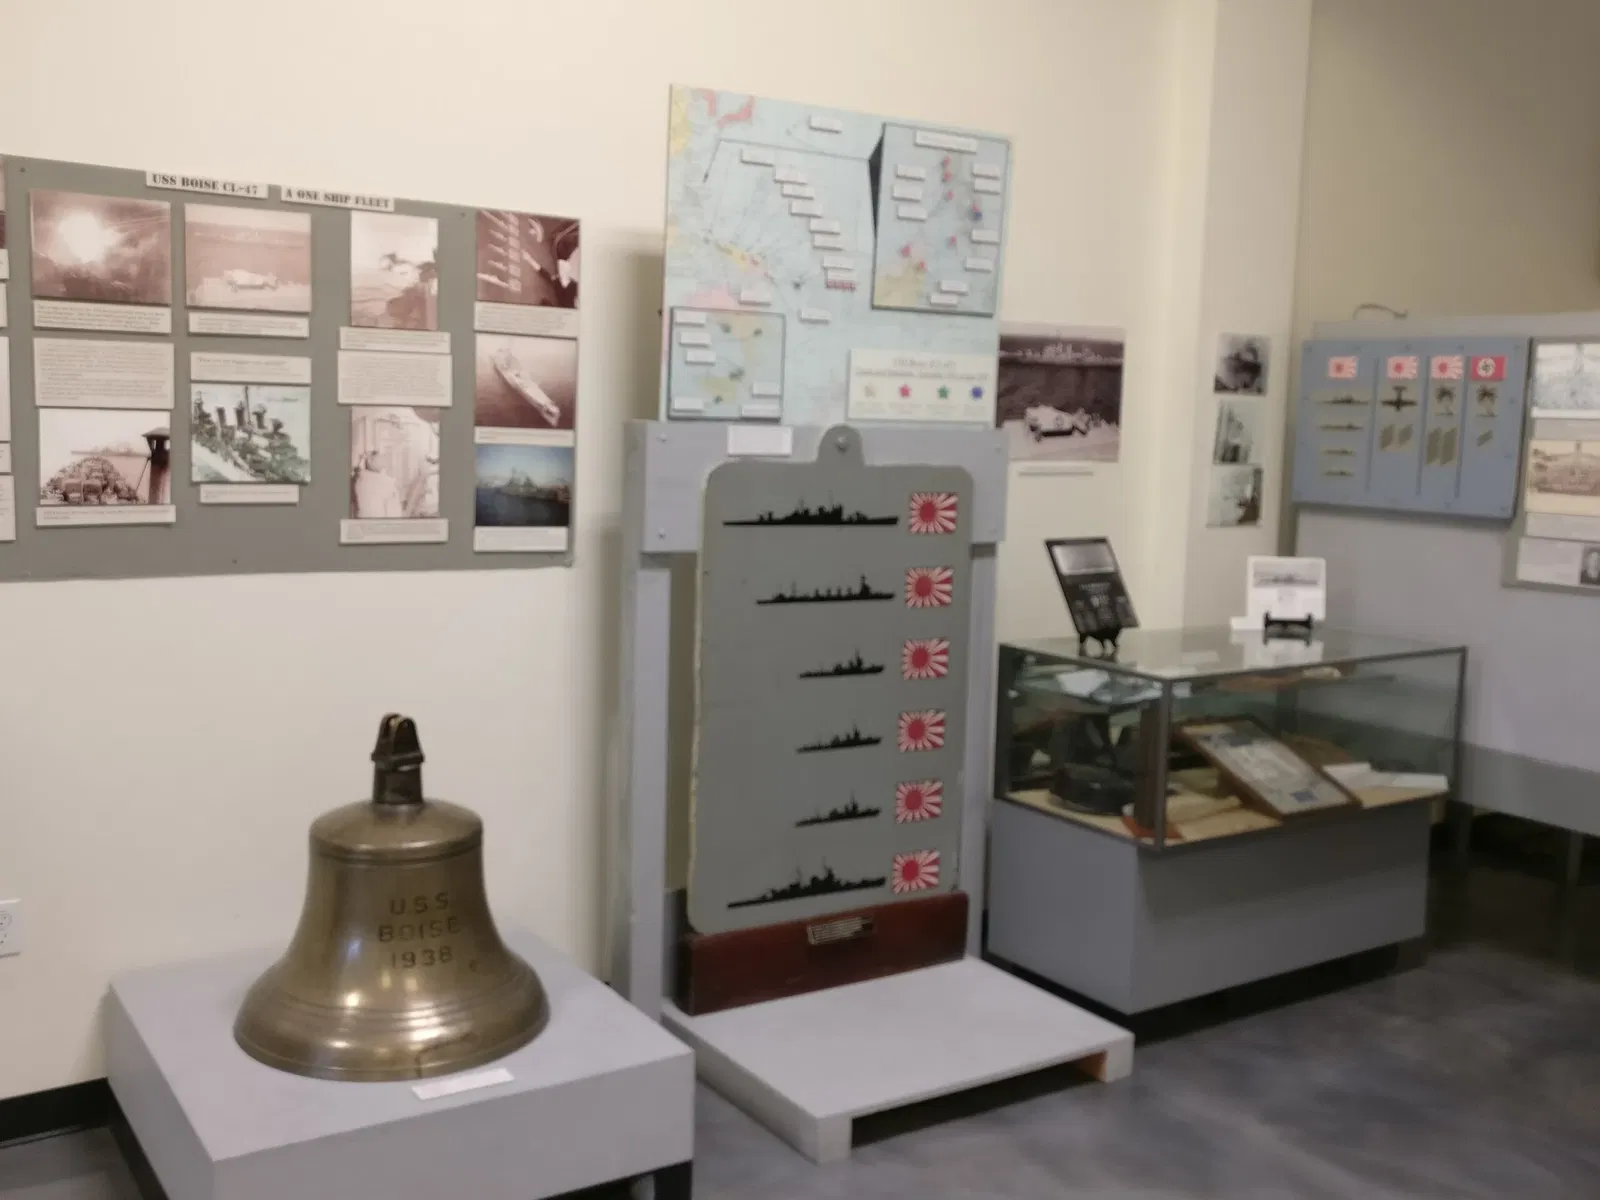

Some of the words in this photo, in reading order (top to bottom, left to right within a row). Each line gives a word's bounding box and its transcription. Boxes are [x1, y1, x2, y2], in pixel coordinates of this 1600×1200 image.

[152, 173, 177, 185] USS
[180, 176, 219, 190] BOISE
[222, 181, 258, 195] CL-47
[285, 187, 293, 198] A
[296, 189, 320, 200] ONE
[323, 192, 352, 204] SHIP
[389, 892, 449, 915] USS
[379, 916, 462, 942] BOISE
[391, 946, 453, 969] 1938
